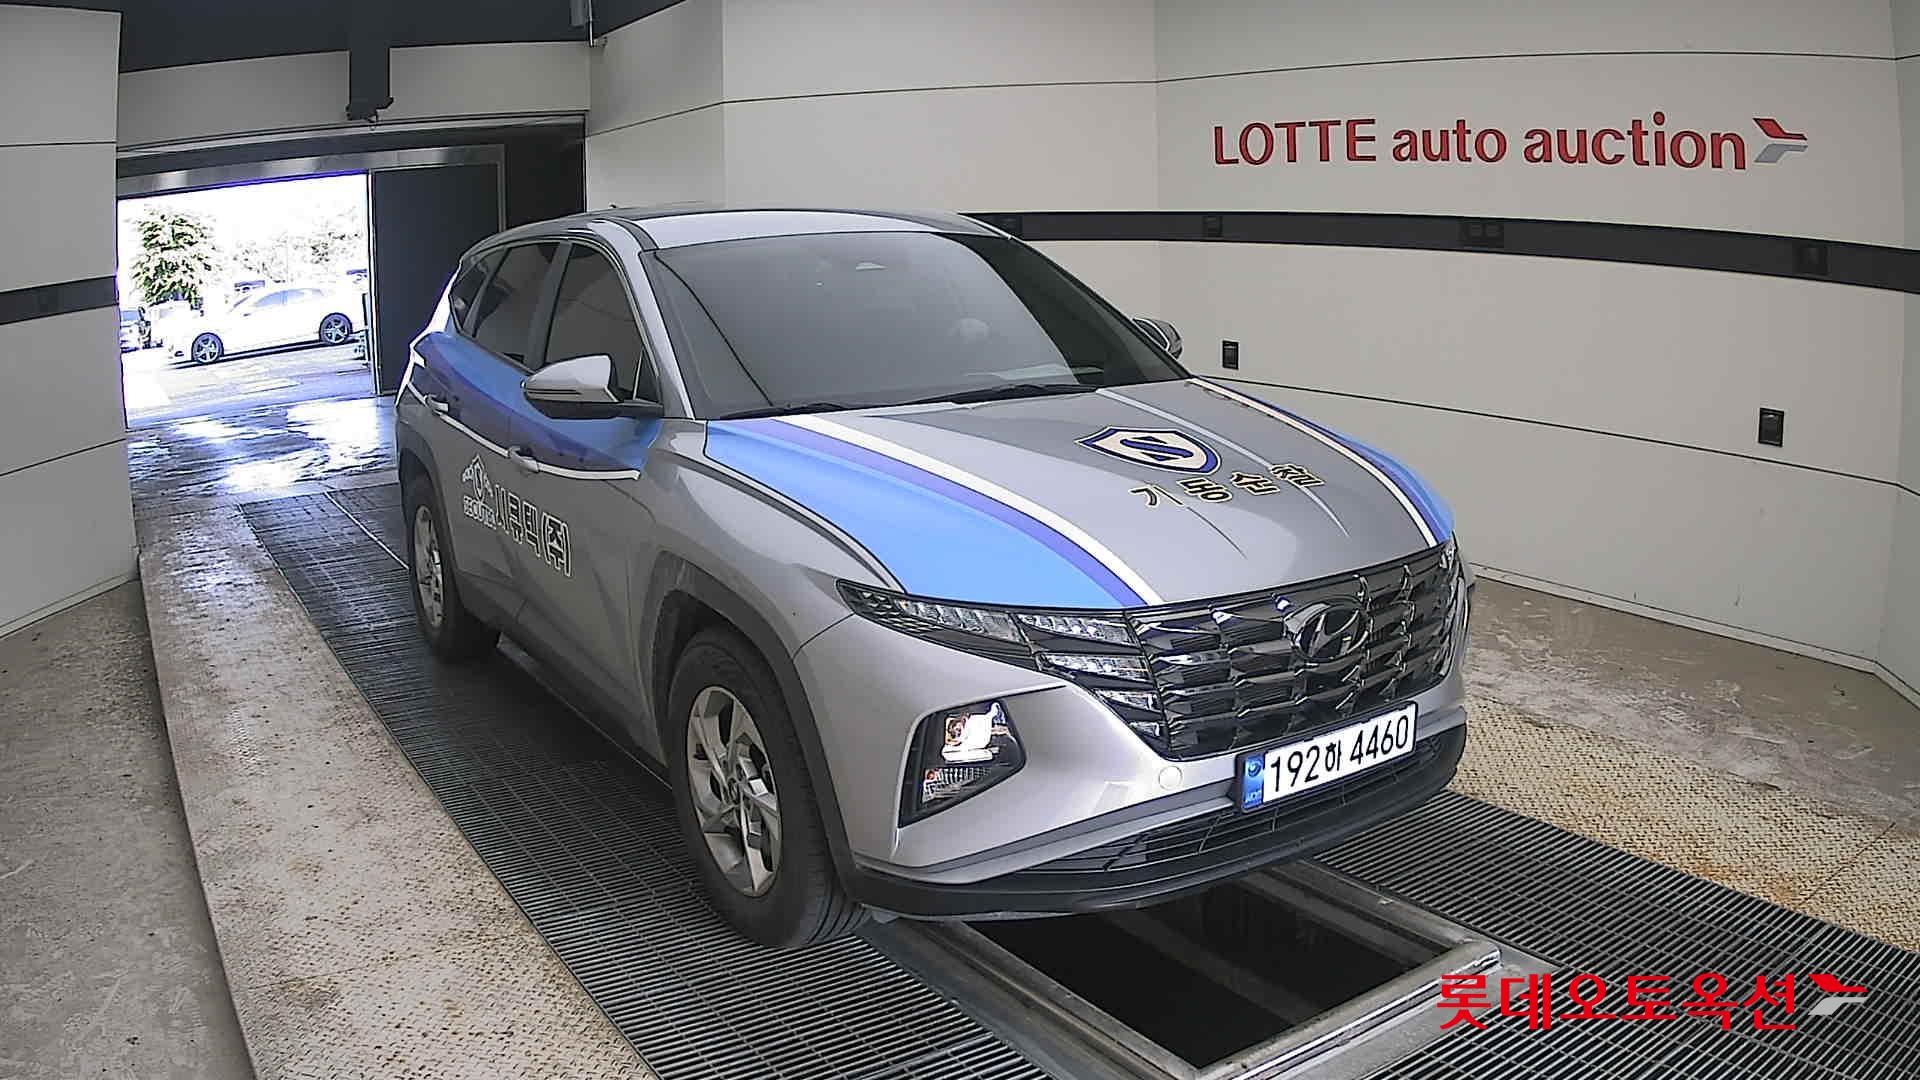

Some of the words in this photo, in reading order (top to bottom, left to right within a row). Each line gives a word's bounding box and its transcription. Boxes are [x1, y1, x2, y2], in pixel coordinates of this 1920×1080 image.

[1213, 117, 1377, 166] LOTTE
[1392, 118, 1508, 163] auto
[1523, 110, 1746, 170] auction
[1270, 738, 1342, 792] 192하
[1350, 714, 1409, 765] 4460
